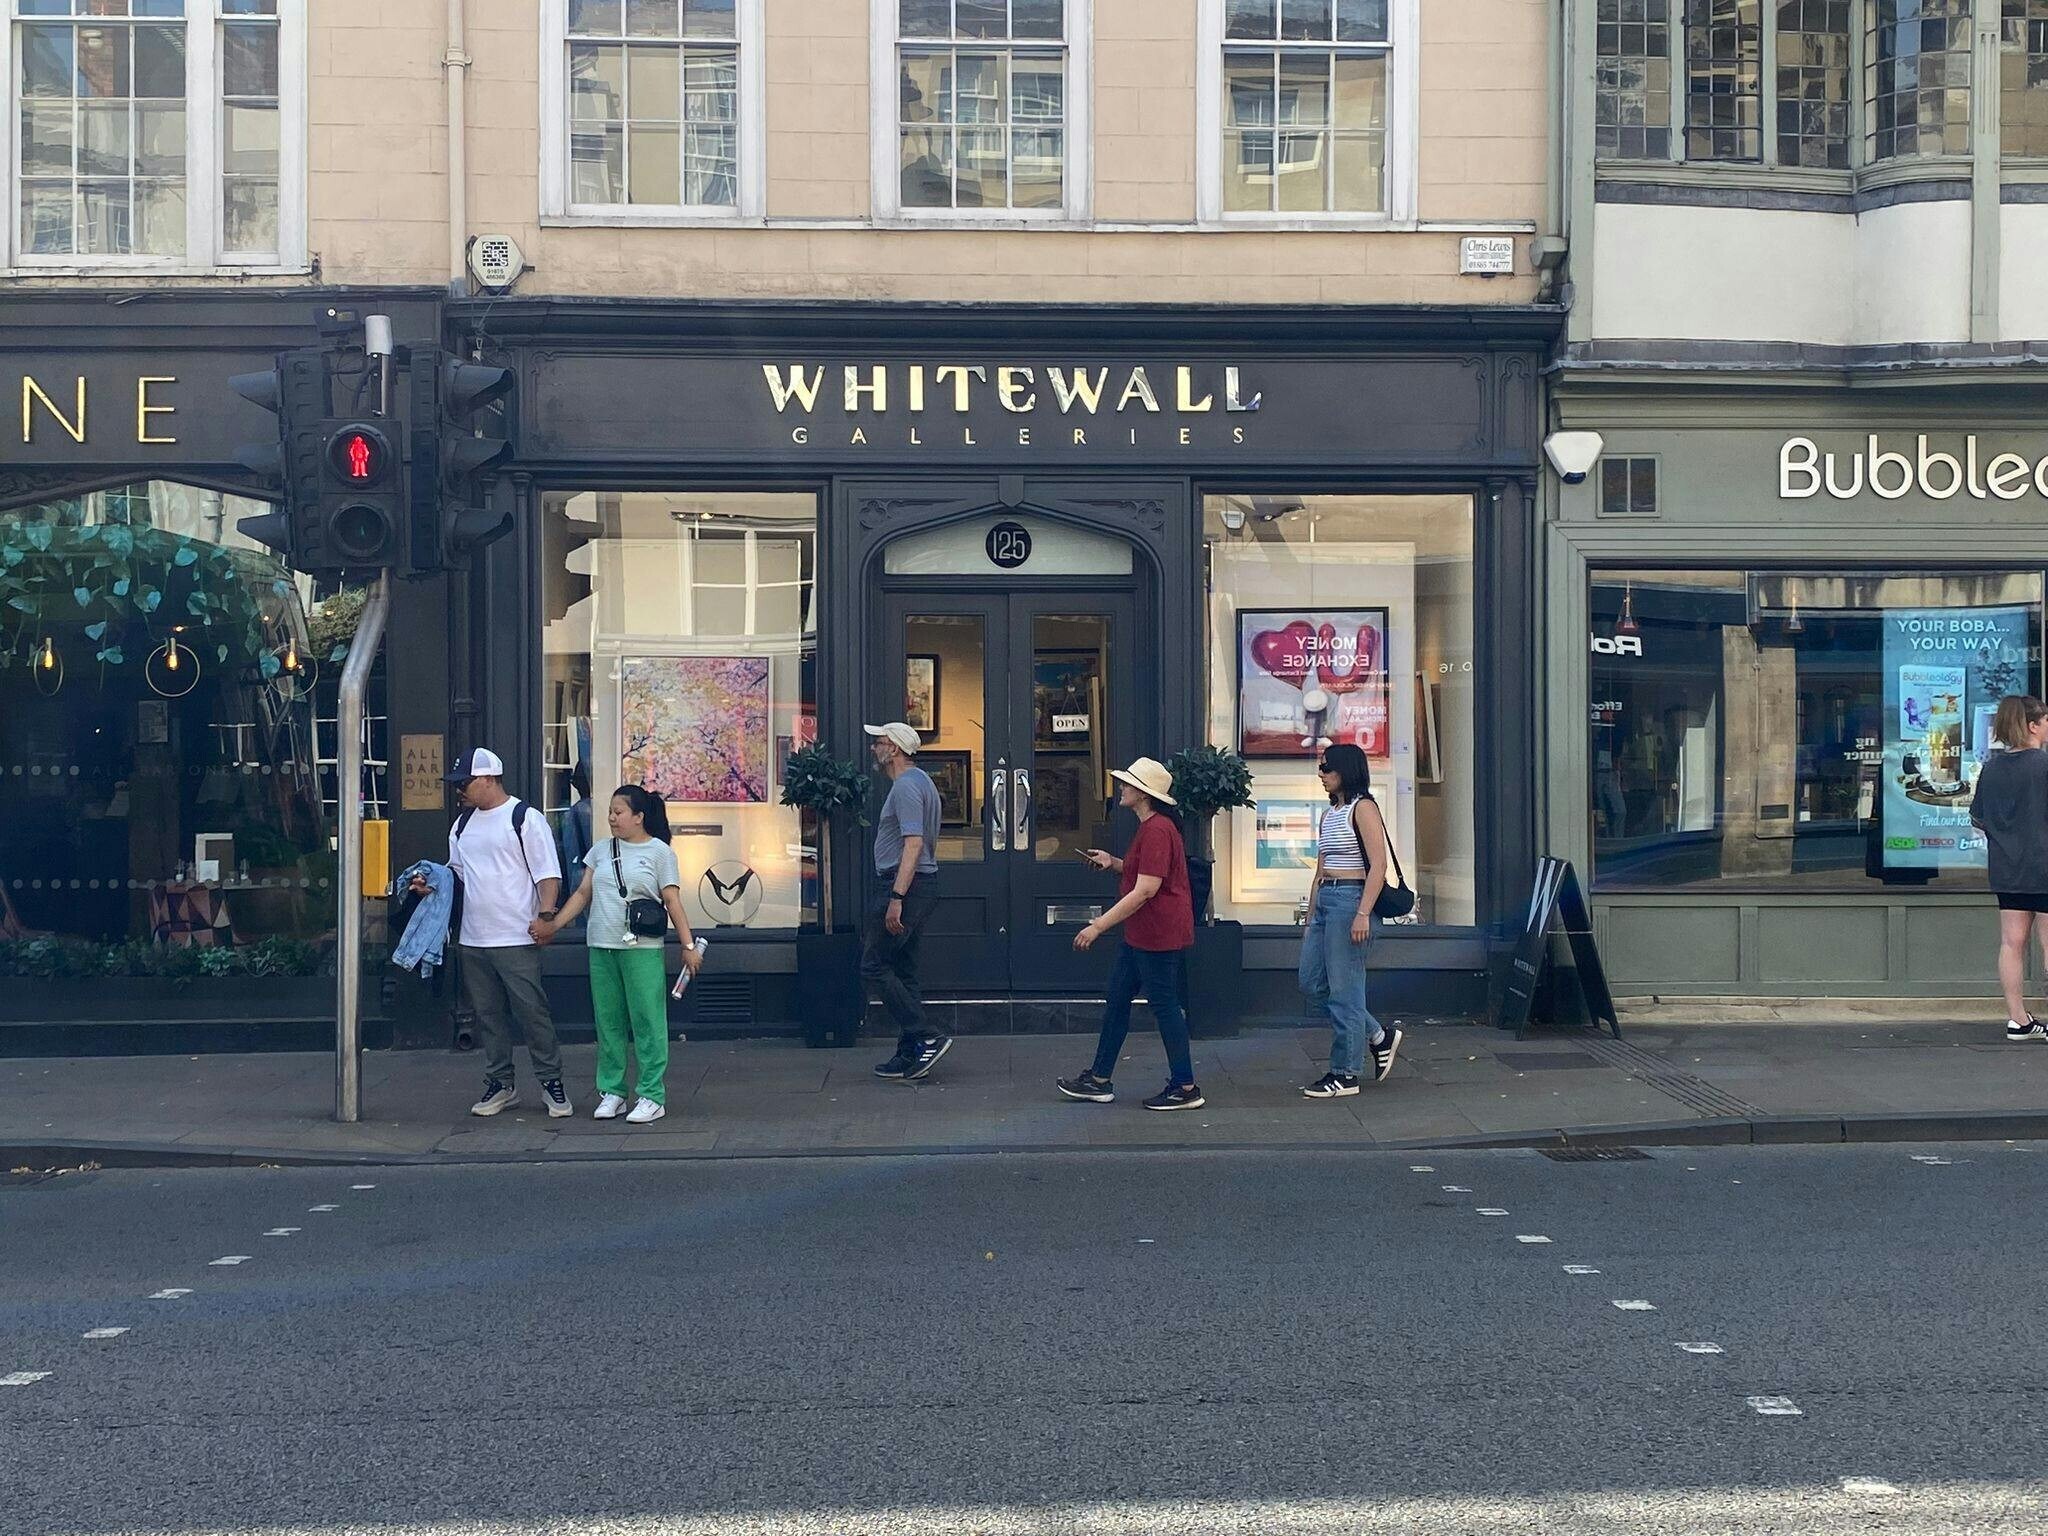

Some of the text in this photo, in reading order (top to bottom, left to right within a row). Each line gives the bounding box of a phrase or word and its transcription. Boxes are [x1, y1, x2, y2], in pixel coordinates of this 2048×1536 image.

[1468, 240, 1511, 251] Chris Lewis
[762, 364, 1262, 415] WHITEWALL
[22, 376, 176, 443] NE
[791, 427, 1245, 445] GALLERIES
[991, 531, 1027, 560] 125
[1897, 620, 2011, 633] YOUR BOBA...
[1910, 637, 2003, 650] YOUR WAY
[1903, 671, 1963, 685] Bubbleology
[1056, 718, 1086, 728] OPEN
[407, 749, 438, 760] ALL
[406, 763, 439, 774] BAR
[405, 779, 441, 790] ONE
[1920, 815, 1939, 826] Find
[1941, 817, 1955, 826] our
[1887, 838, 1916, 848] ASDA
[1920, 838, 1955, 846] TESCO
